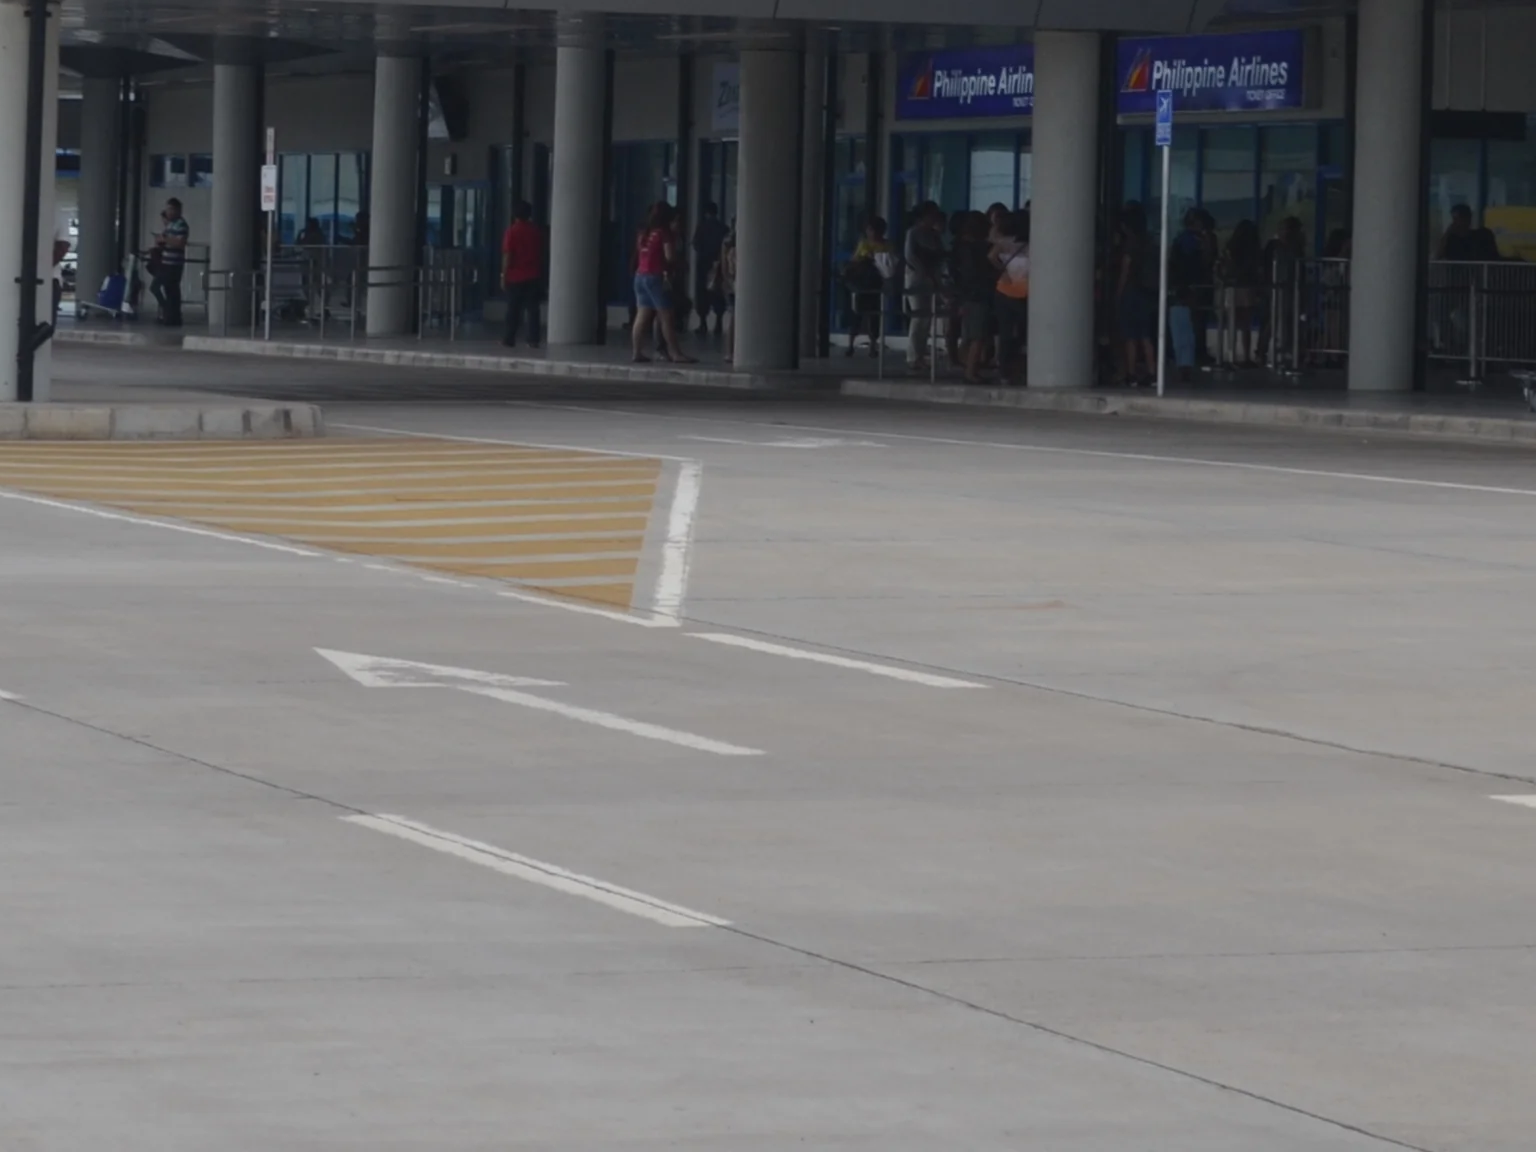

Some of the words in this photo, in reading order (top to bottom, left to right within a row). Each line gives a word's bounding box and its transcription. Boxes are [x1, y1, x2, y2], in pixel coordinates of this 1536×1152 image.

[932, 67, 996, 105] Philippine
[1152, 58, 1225, 97] Philippine
[1228, 54, 1289, 88] Airlines
